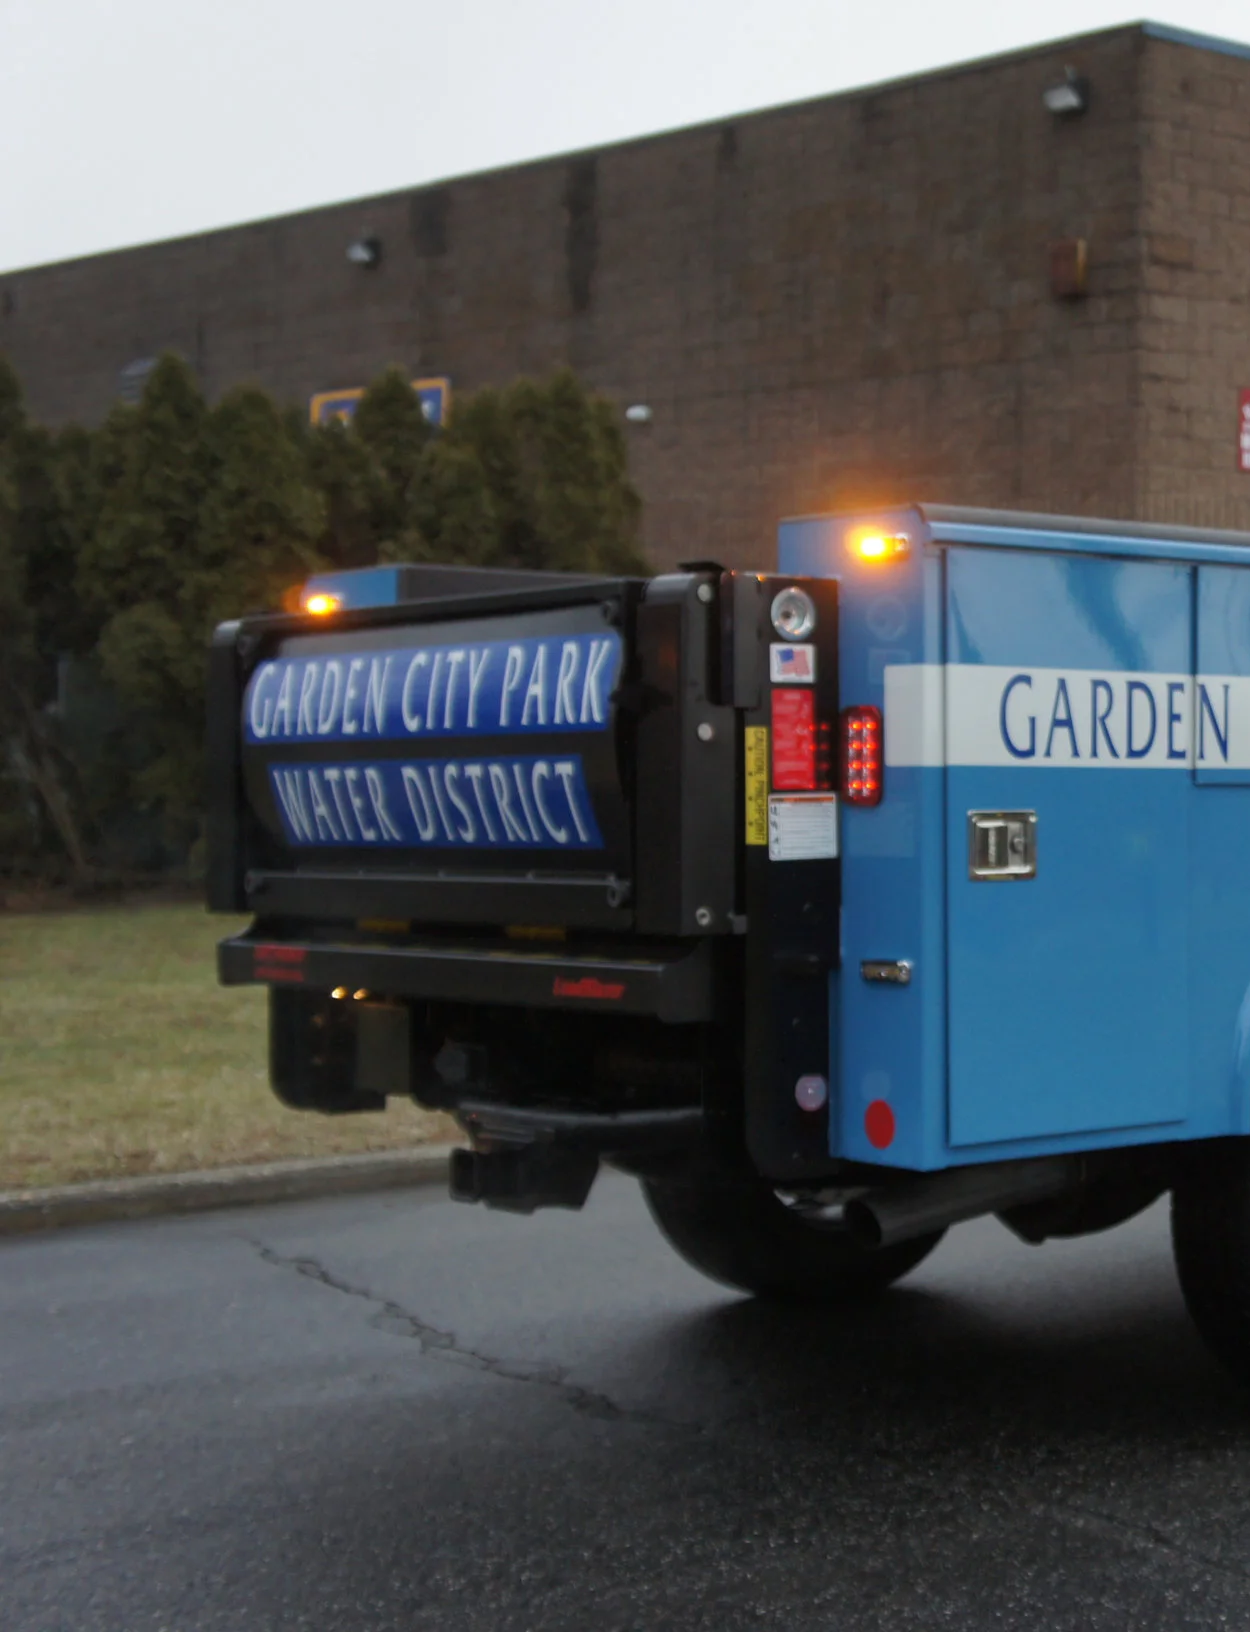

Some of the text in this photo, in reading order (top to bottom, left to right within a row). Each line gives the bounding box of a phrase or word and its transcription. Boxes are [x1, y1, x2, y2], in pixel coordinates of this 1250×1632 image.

[252, 640, 611, 738] GARDEN CITY PARK
[999, 673, 1230, 763] GARDEN
[273, 760, 587, 844] WATER DISTRICT
